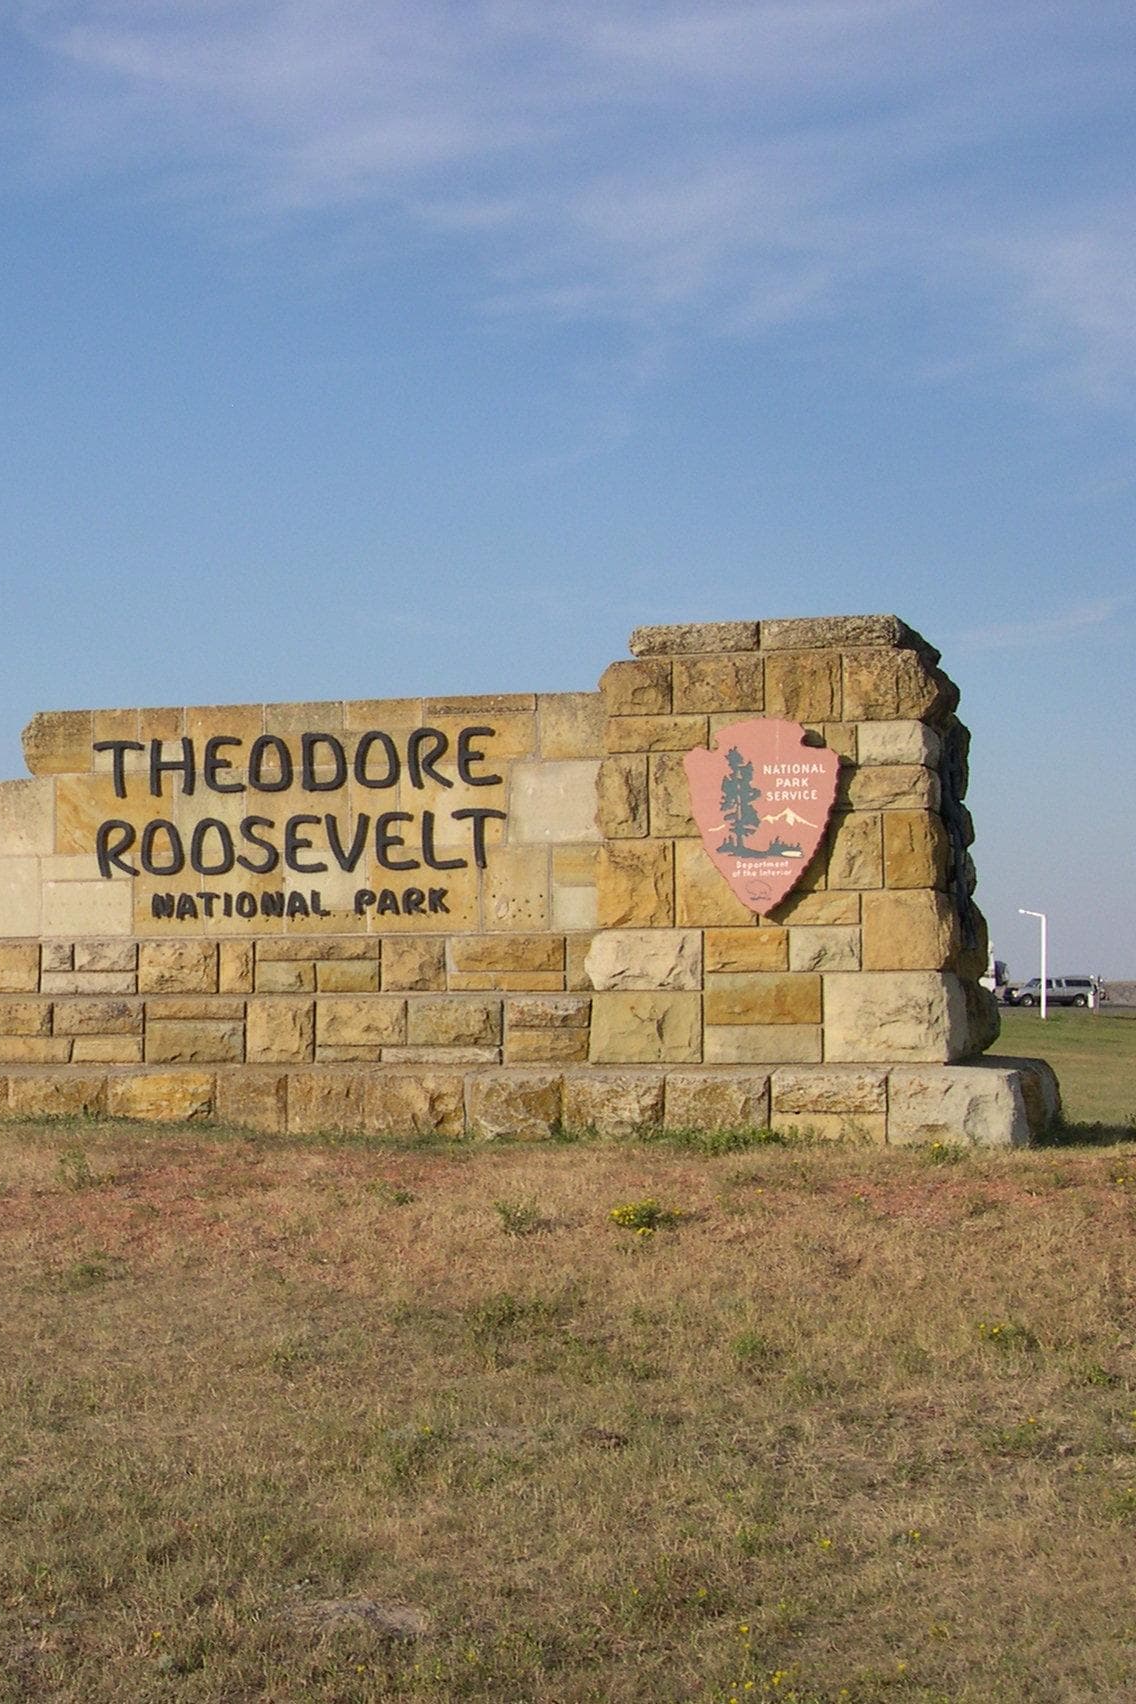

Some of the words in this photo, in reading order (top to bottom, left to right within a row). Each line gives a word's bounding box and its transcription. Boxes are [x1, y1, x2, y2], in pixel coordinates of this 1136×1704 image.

[93, 727, 503, 799] THEODORE
[763, 763, 826, 775] NATIONAL
[775, 778, 809, 788] PARK
[766, 790, 818, 801] SERVICE
[96, 808, 507, 879] ROOSEVELT
[736, 860, 789, 869] Department
[732, 870, 741, 878] of
[151, 889, 331, 921] NATIONAL
[354, 887, 450, 916] PARK
